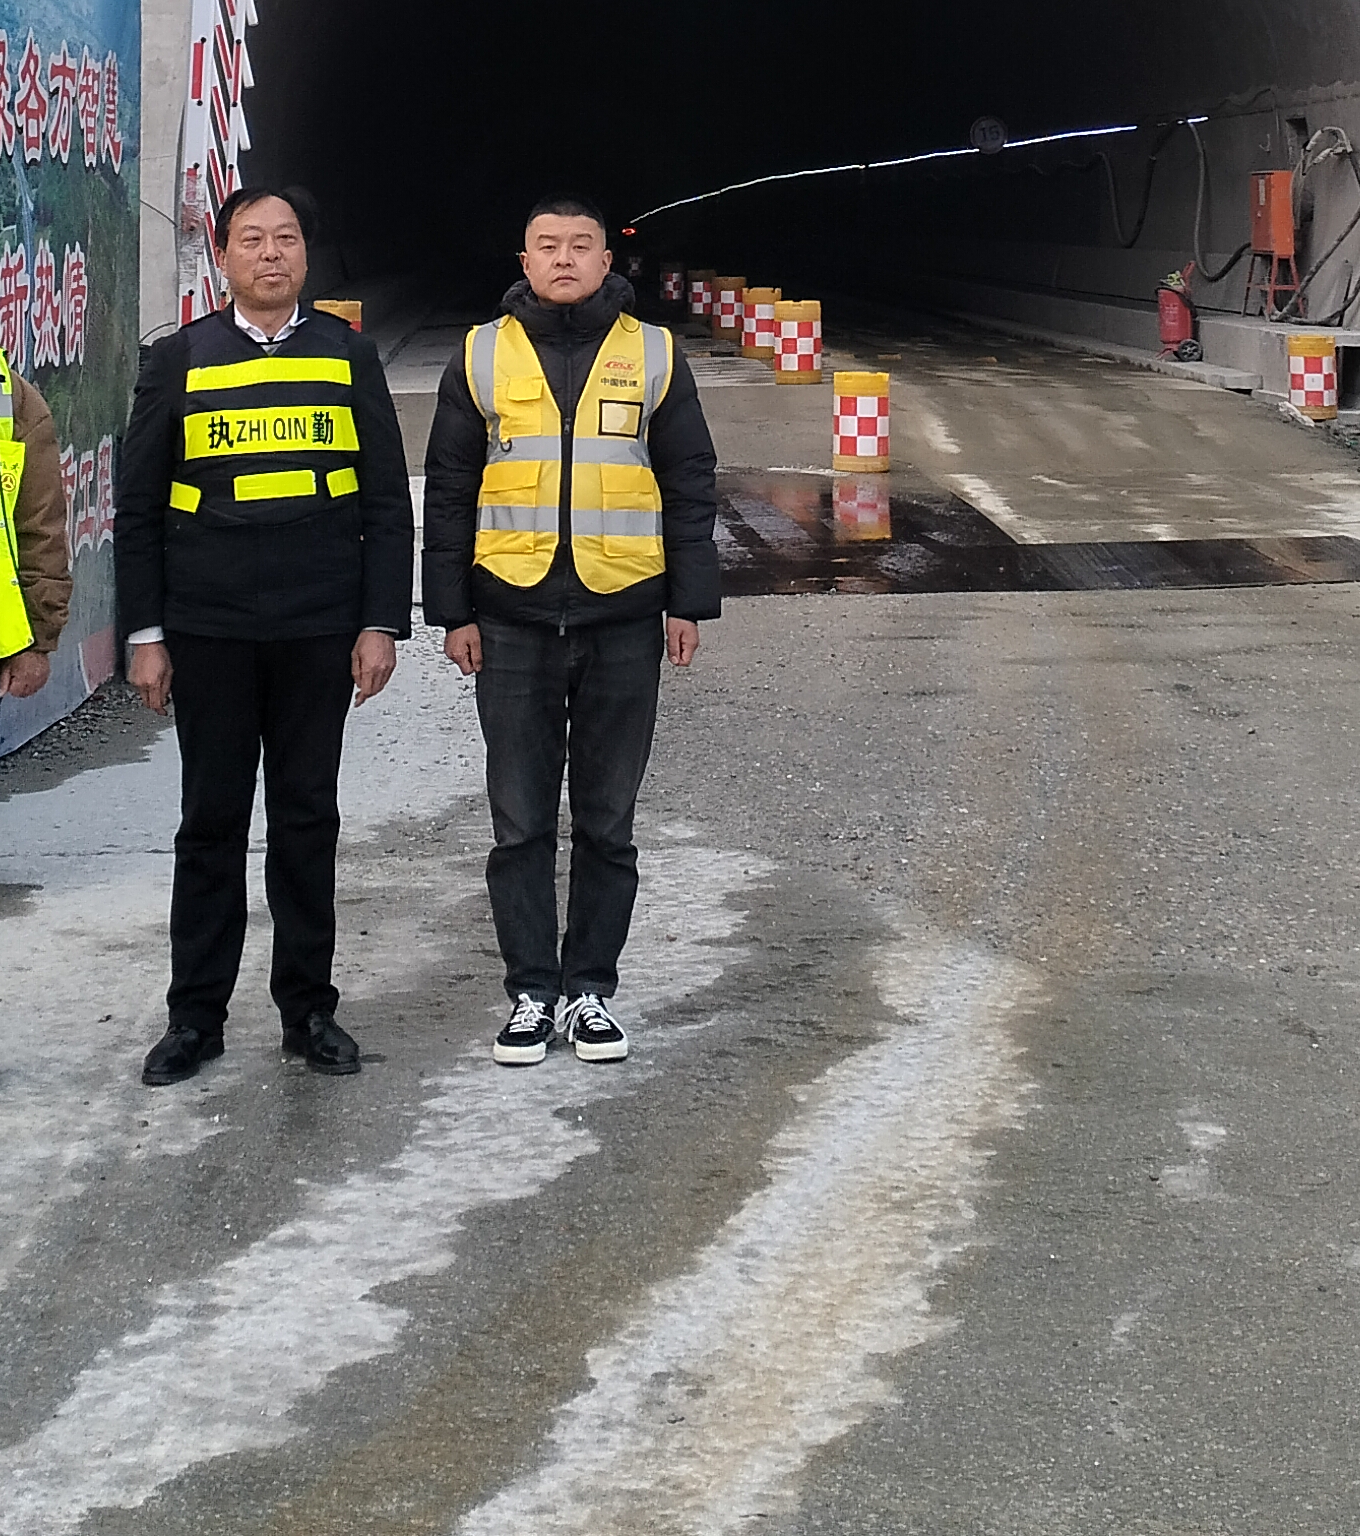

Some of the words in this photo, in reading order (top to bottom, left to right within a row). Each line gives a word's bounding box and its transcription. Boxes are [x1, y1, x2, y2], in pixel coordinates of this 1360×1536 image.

[208, 416, 234, 449] 执
[236, 419, 268, 442] ZHI
[273, 417, 307, 441] QIN
[311, 411, 334, 446] 勤
